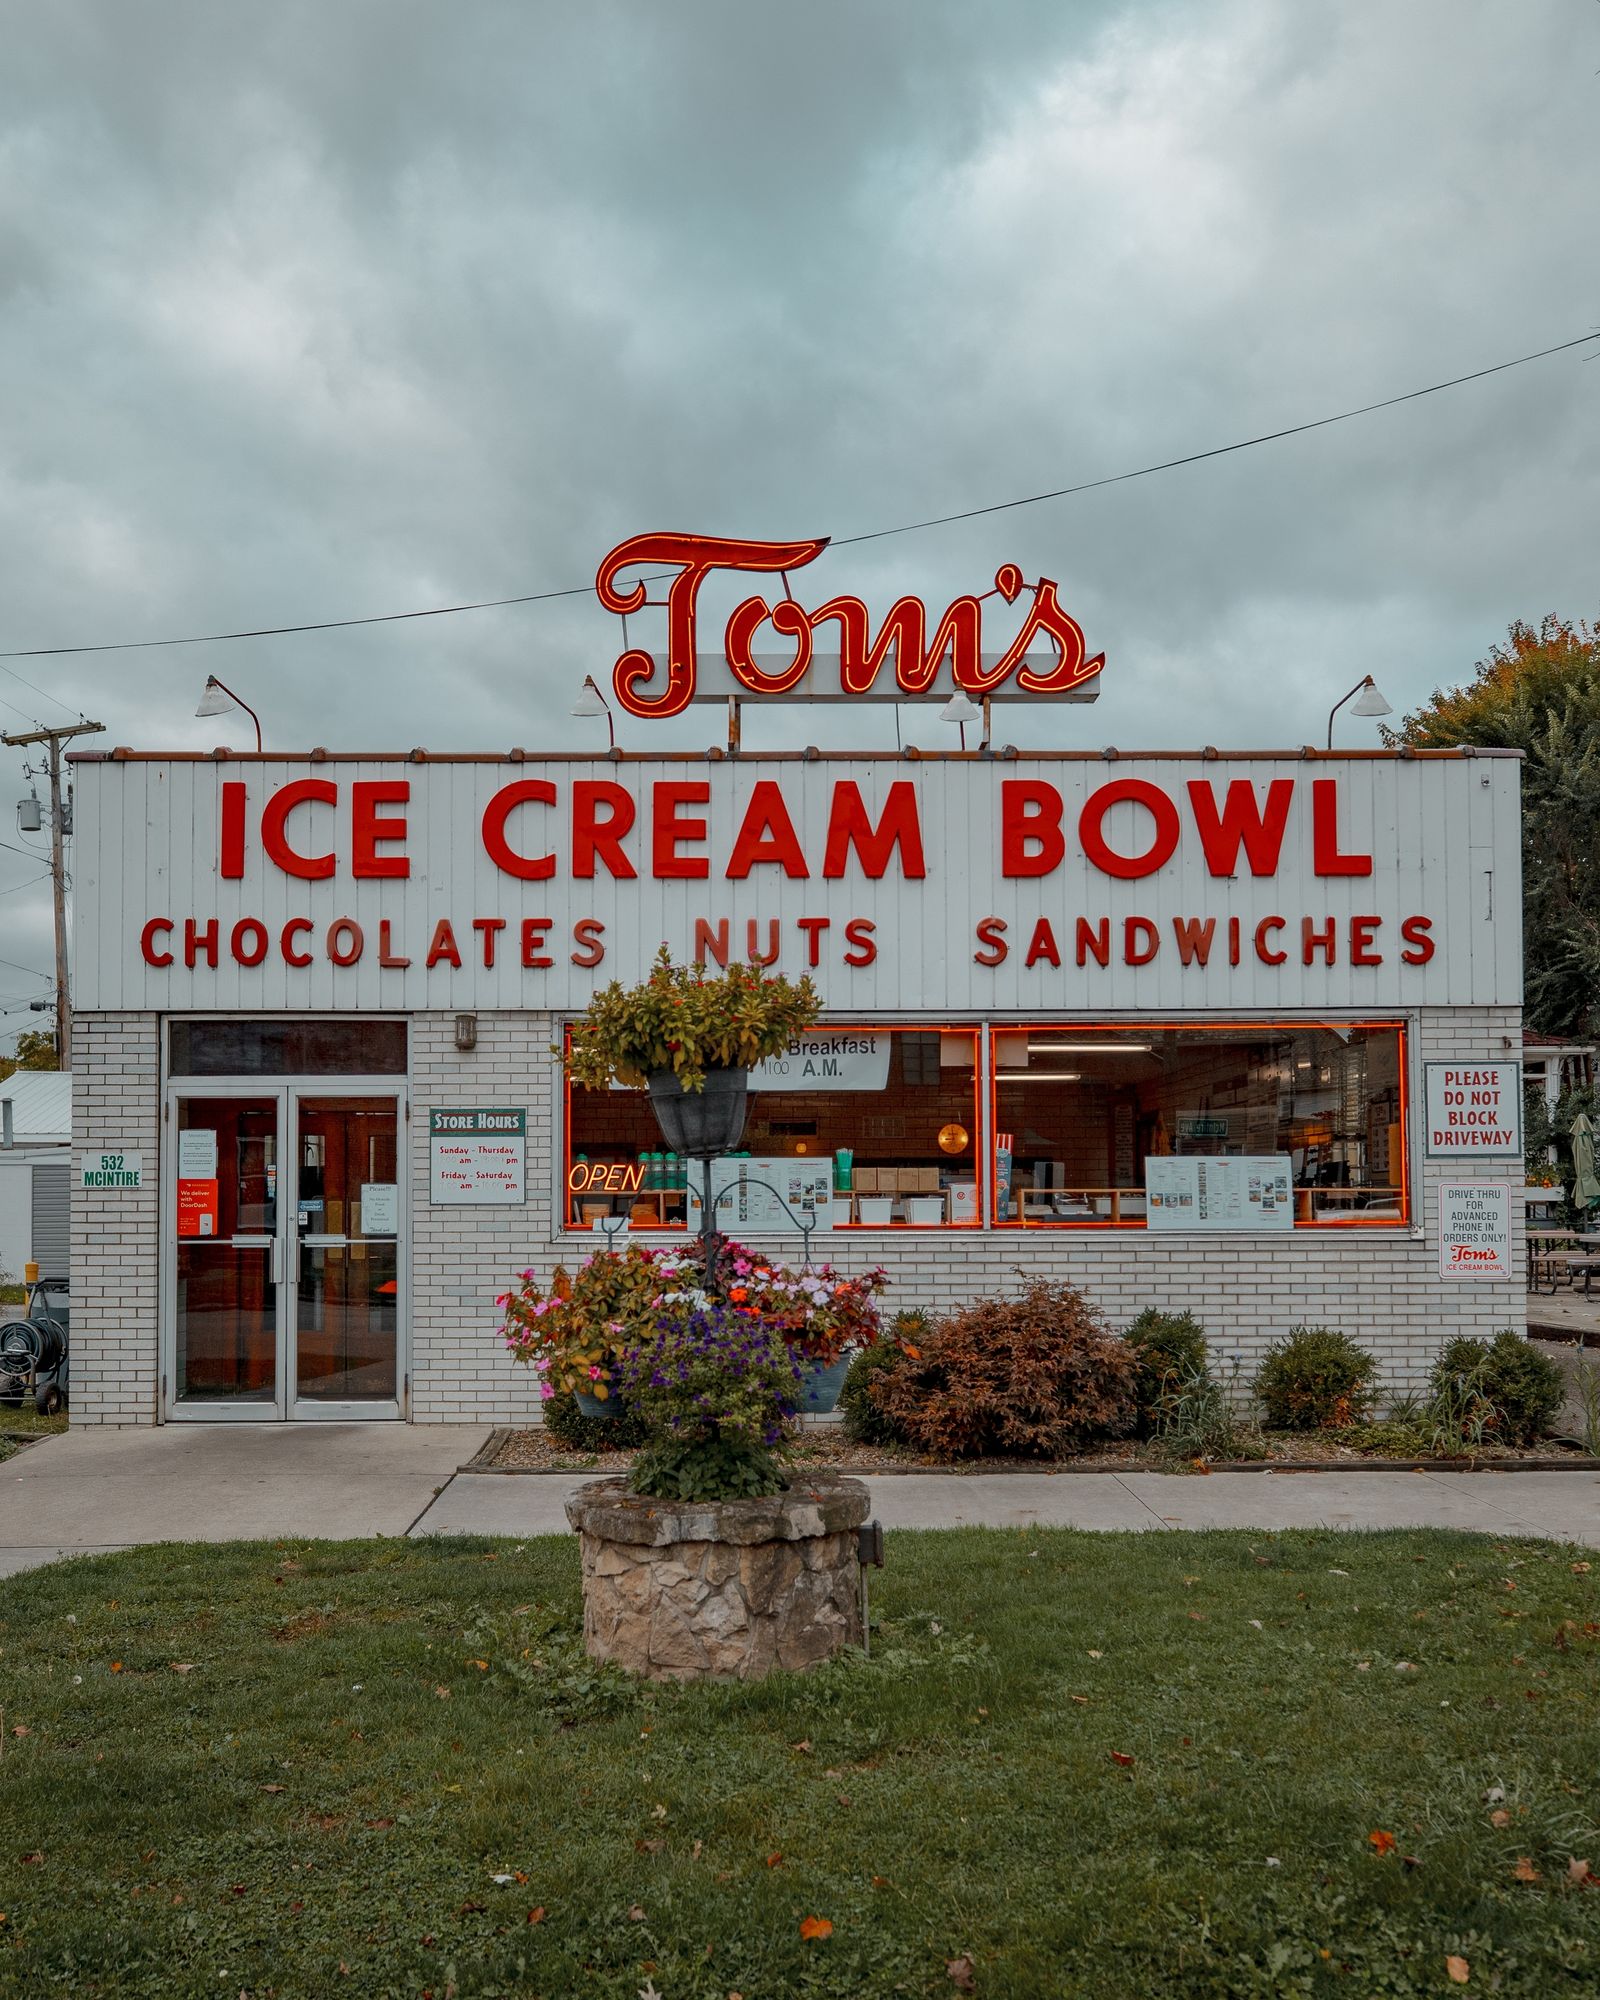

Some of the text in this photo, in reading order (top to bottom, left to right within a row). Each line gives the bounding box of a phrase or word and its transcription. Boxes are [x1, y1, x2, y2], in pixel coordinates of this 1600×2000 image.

[596, 532, 1105, 718] Tom's
[220, 777, 1374, 879] ICE CREAM BOWL
[140, 915, 1435, 967] CHOCOLATES NUTS SANDWICHES
[788, 1036, 876, 1056] Breakfast
[802, 1058, 843, 1077] A.M.
[1445, 1071, 1499, 1086] PLEASE
[1444, 1091, 1501, 1106] DO NOT
[434, 1113, 519, 1129] STORE HOURS
[1448, 1111, 1498, 1126] BLOCK
[1433, 1130, 1513, 1146] DRIVEWAY
[440, 1146, 469, 1155] Sunday
[478, 1146, 514, 1155] Thursday
[101, 1155, 124, 1170] 532
[84, 1171, 139, 1186] MCINTIRE
[441, 1171, 467, 1180] Friday
[476, 1171, 513, 1180] Saturday
[569, 1163, 646, 1191] OPEN
[1448, 1190, 1501, 1199] DRIVE THRU
[1466, 1201, 1484, 1210] FOR
[1451, 1212, 1498, 1221] ADVANCED
[1453, 1223, 1494, 1231] PHONE IN
[1443, 1234, 1507, 1243] ORDERS ONLY!
[1450, 1245, 1500, 1262] Tom's
